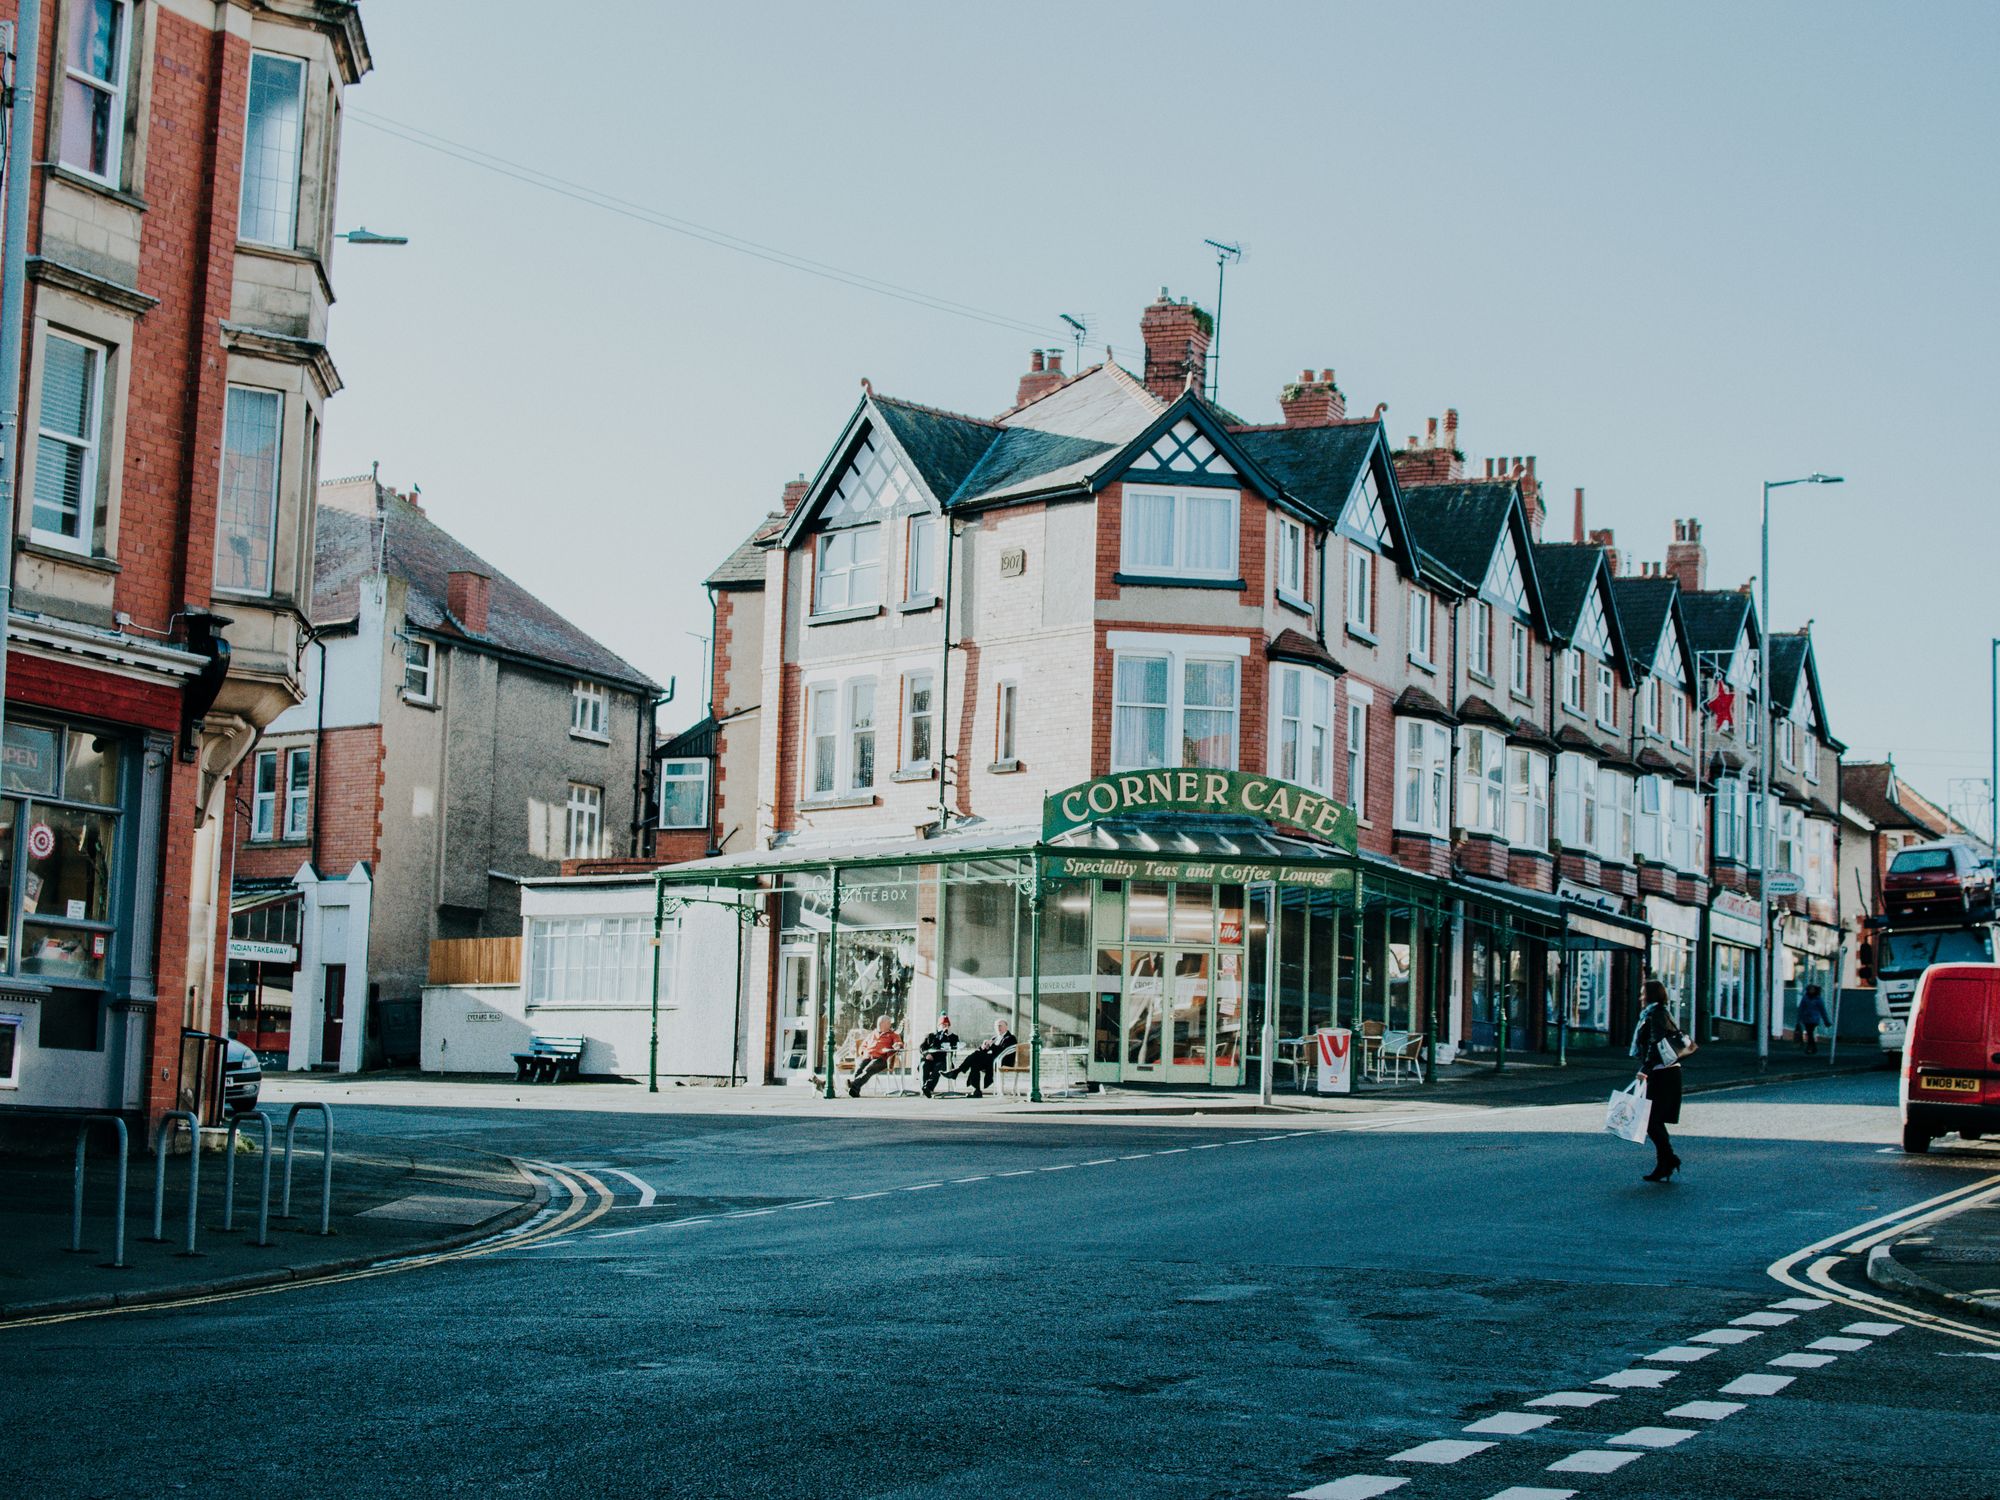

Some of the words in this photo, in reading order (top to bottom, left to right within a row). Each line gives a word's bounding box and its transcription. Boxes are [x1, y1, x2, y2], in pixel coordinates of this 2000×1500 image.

[1001, 555, 1020, 570] 1907
[4, 747, 38, 768] PEN
[1062, 773, 1230, 822] CORNER
[1241, 780, 1341, 836] CAFÉ
[1063, 857, 1137, 876] Speciality
[1145, 861, 1179, 877] Teas
[1186, 863, 1213, 878] and
[1220, 863, 1271, 882] Coffee
[1278, 867, 1333, 887] Lounge
[882, 889, 908, 901] BOX
[1221, 925, 1239, 942] illy
[231, 944, 252, 952] INDIAN
[254, 946, 288, 955] TAKEAWAY
